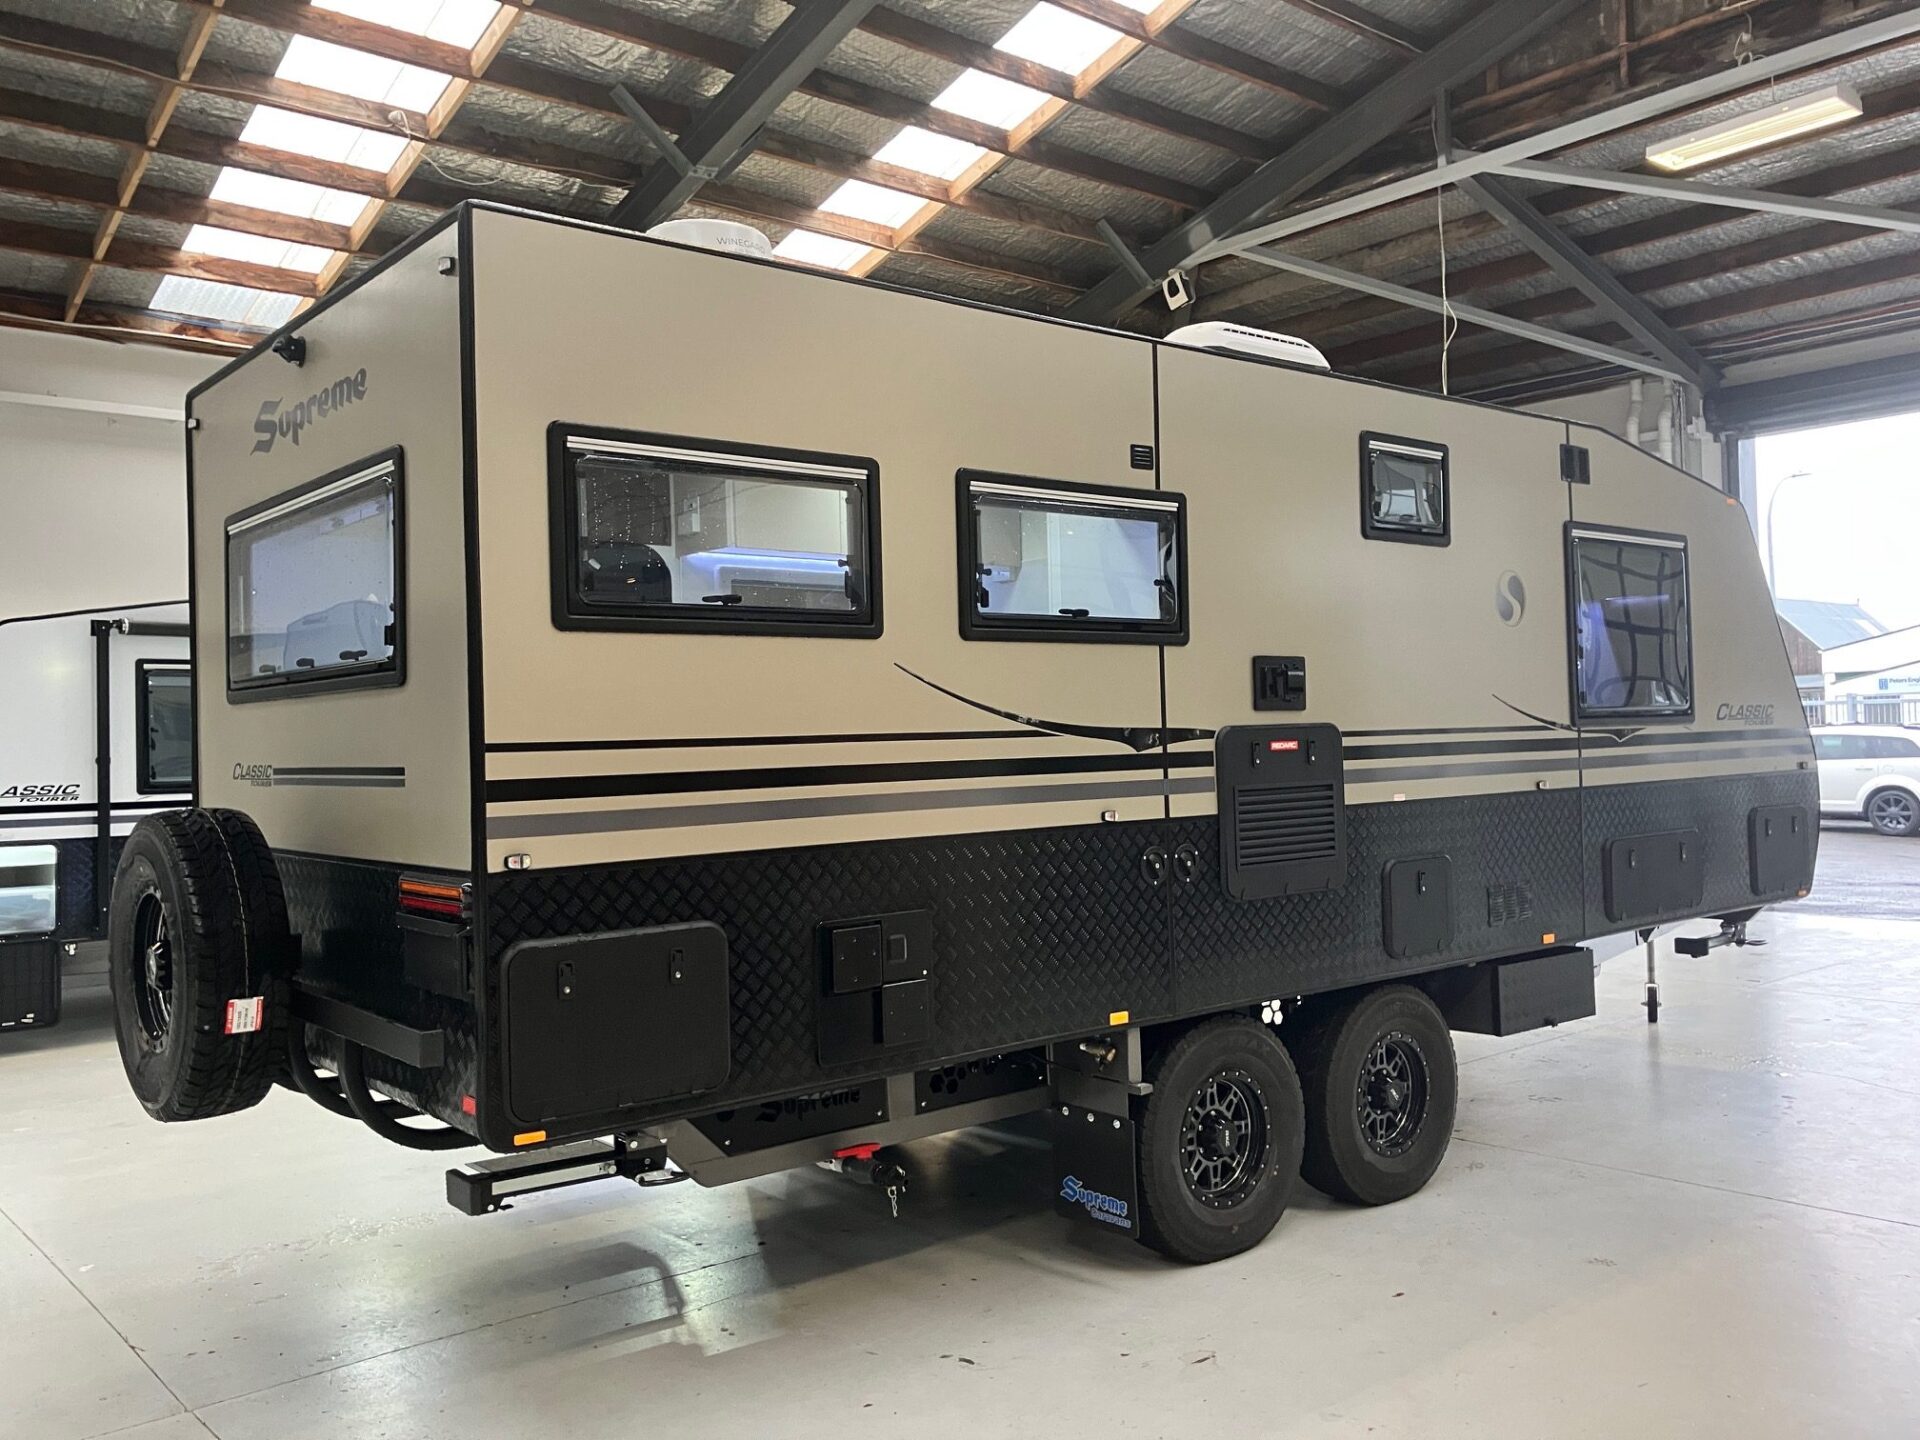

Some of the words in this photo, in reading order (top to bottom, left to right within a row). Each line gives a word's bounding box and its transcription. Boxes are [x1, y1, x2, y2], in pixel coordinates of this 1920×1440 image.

[250, 368, 368, 456] Supreme
[1716, 703, 1775, 720] CLASSIC
[232, 762, 272, 780] CLASSIC
[1060, 1175, 1128, 1217] Supreme
